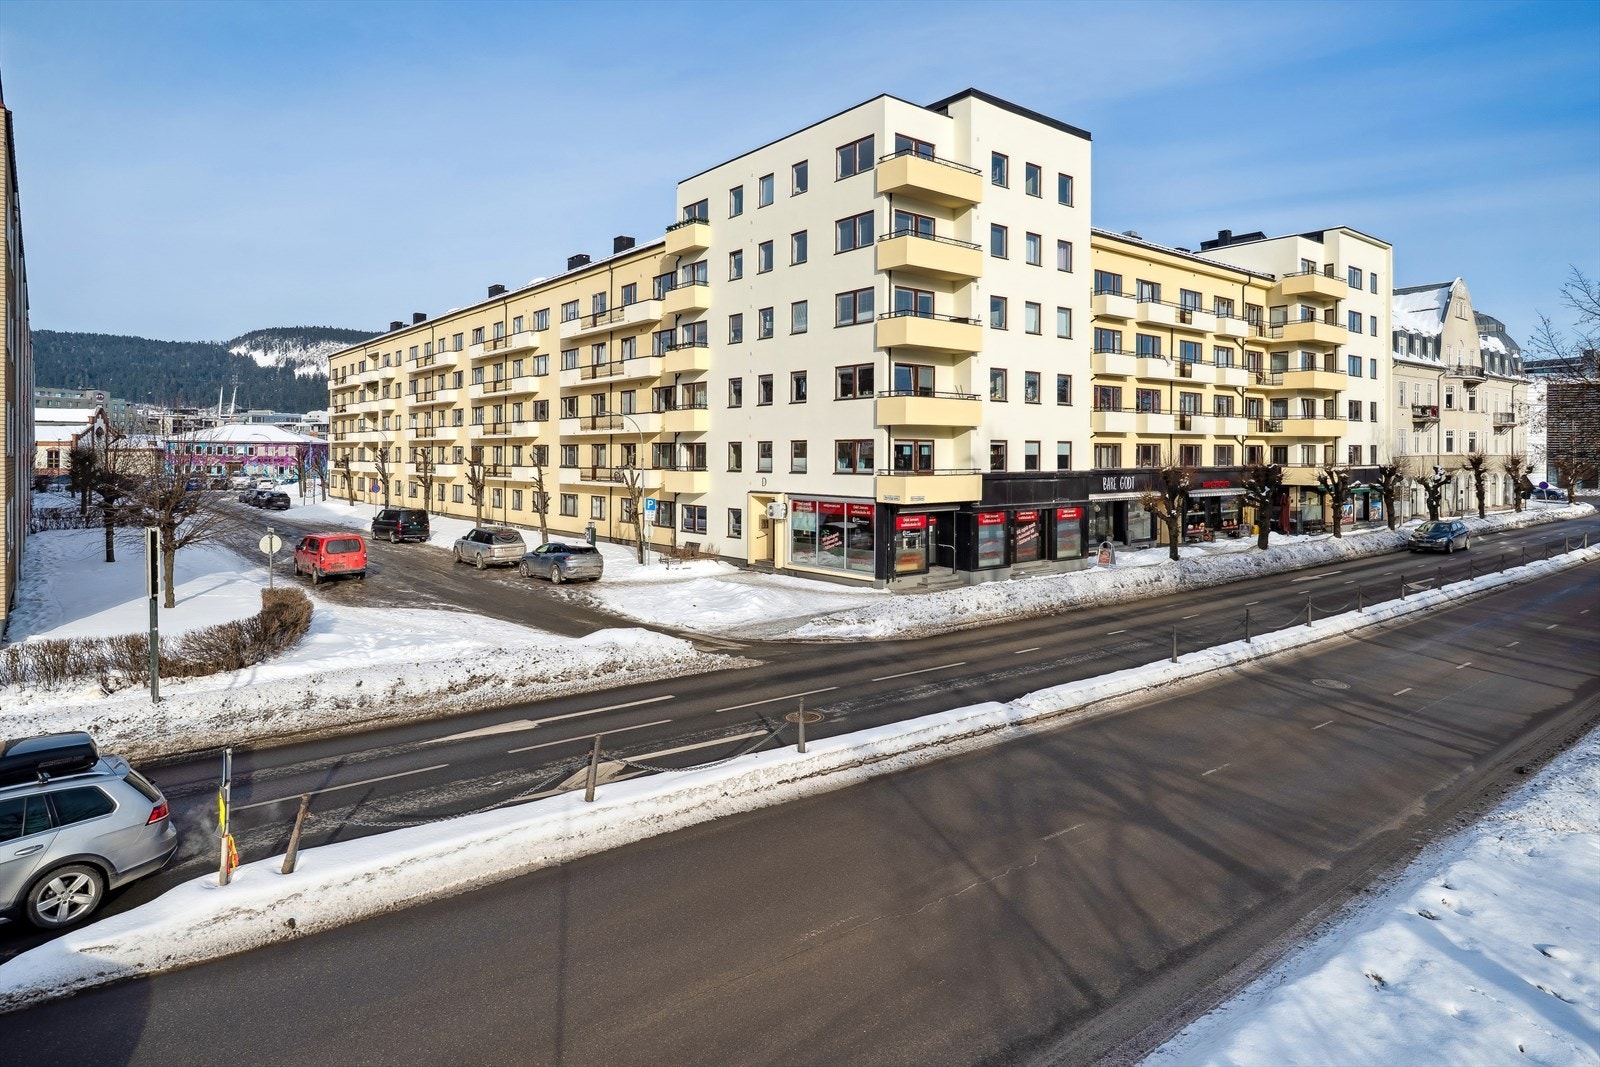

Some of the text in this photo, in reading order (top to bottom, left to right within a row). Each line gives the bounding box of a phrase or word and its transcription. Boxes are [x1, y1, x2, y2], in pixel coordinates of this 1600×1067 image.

[761, 476, 767, 487] D
[1102, 476, 1135, 491] BARE GODT
[647, 499, 655, 509] P
